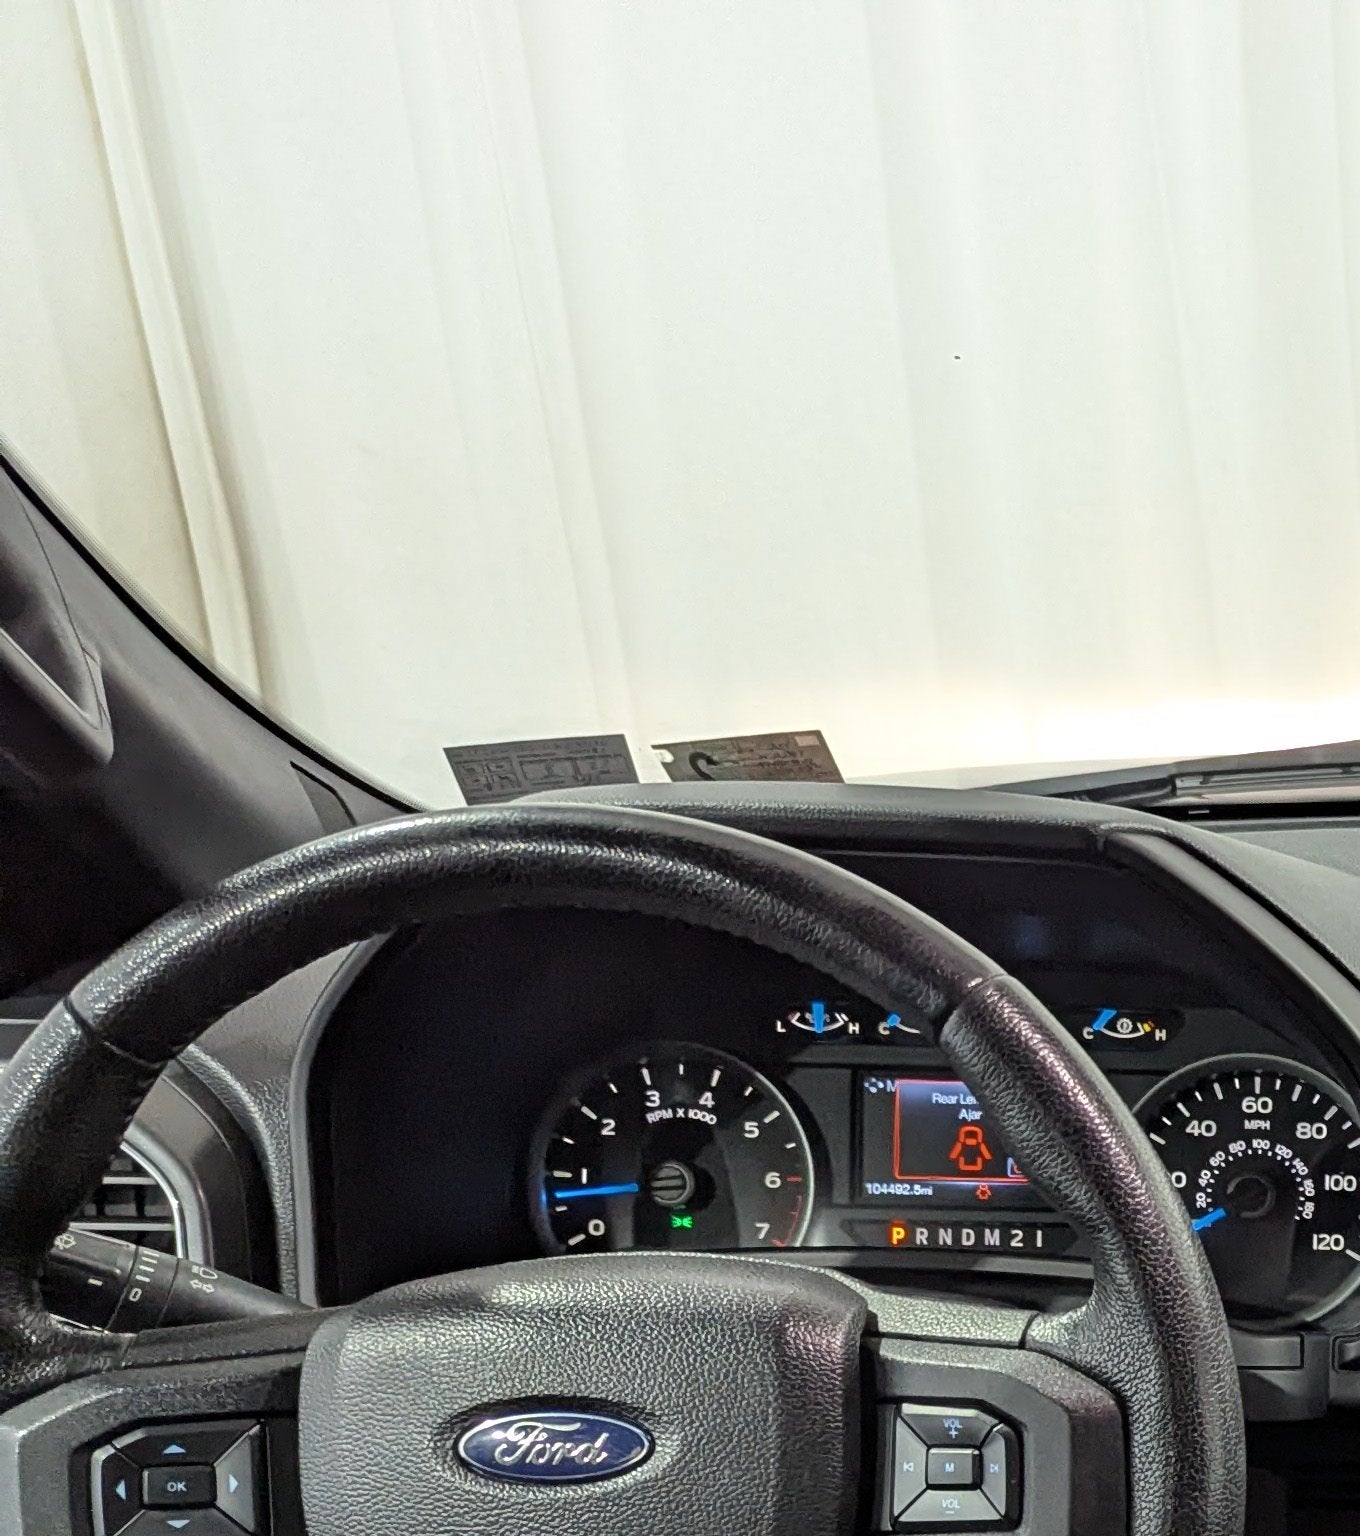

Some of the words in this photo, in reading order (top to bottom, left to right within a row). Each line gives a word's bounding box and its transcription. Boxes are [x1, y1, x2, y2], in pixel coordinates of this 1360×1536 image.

[776, 1020, 786, 1032] L
[848, 1022, 860, 1034] H
[1082, 1026, 1094, 1039] C
[1155, 1029, 1167, 1041] H
[645, 1090, 661, 1108] 3
[699, 1091, 716, 1108] 4
[932, 1093, 958, 1104] Rear
[1241, 1096, 1273, 1114] 60
[645, 1108, 673, 1124] RPM
[676, 1108, 685, 1118] X
[688, 1109, 717, 1125] 1000
[958, 1108, 983, 1122] Ajar
[600, 1118, 616, 1136] 2
[743, 1121, 759, 1138] 5
[1185, 1120, 1217, 1137] 40
[1244, 1119, 1270, 1131] MPH
[1295, 1122, 1328, 1140] 80
[1251, 1139, 1271, 1150] 100
[1209, 1150, 1226, 1167] 60
[581, 1168, 588, 1184] 1
[764, 1172, 782, 1189] 6
[1198, 1169, 1212, 1188] 40
[1324, 1173, 1357, 1192] 100
[1195, 1192, 1206, 1209] 20
[588, 1219, 605, 1236] 0
[755, 1222, 770, 1239] 7
[892, 1227, 906, 1244] P
[915, 1228, 929, 1245] R
[938, 1228, 952, 1246] N
[961, 1229, 975, 1246] D
[984, 1229, 1000, 1246] M
[1010, 1230, 1024, 1247] 2
[1312, 1233, 1345, 1251] 120
[943, 1417, 962, 1429] VOL
[492, 1421, 610, 1466] Ford
[945, 1462, 955, 1472] M
[166, 1481, 188, 1493] OK
[941, 1499, 961, 1509] VOL
